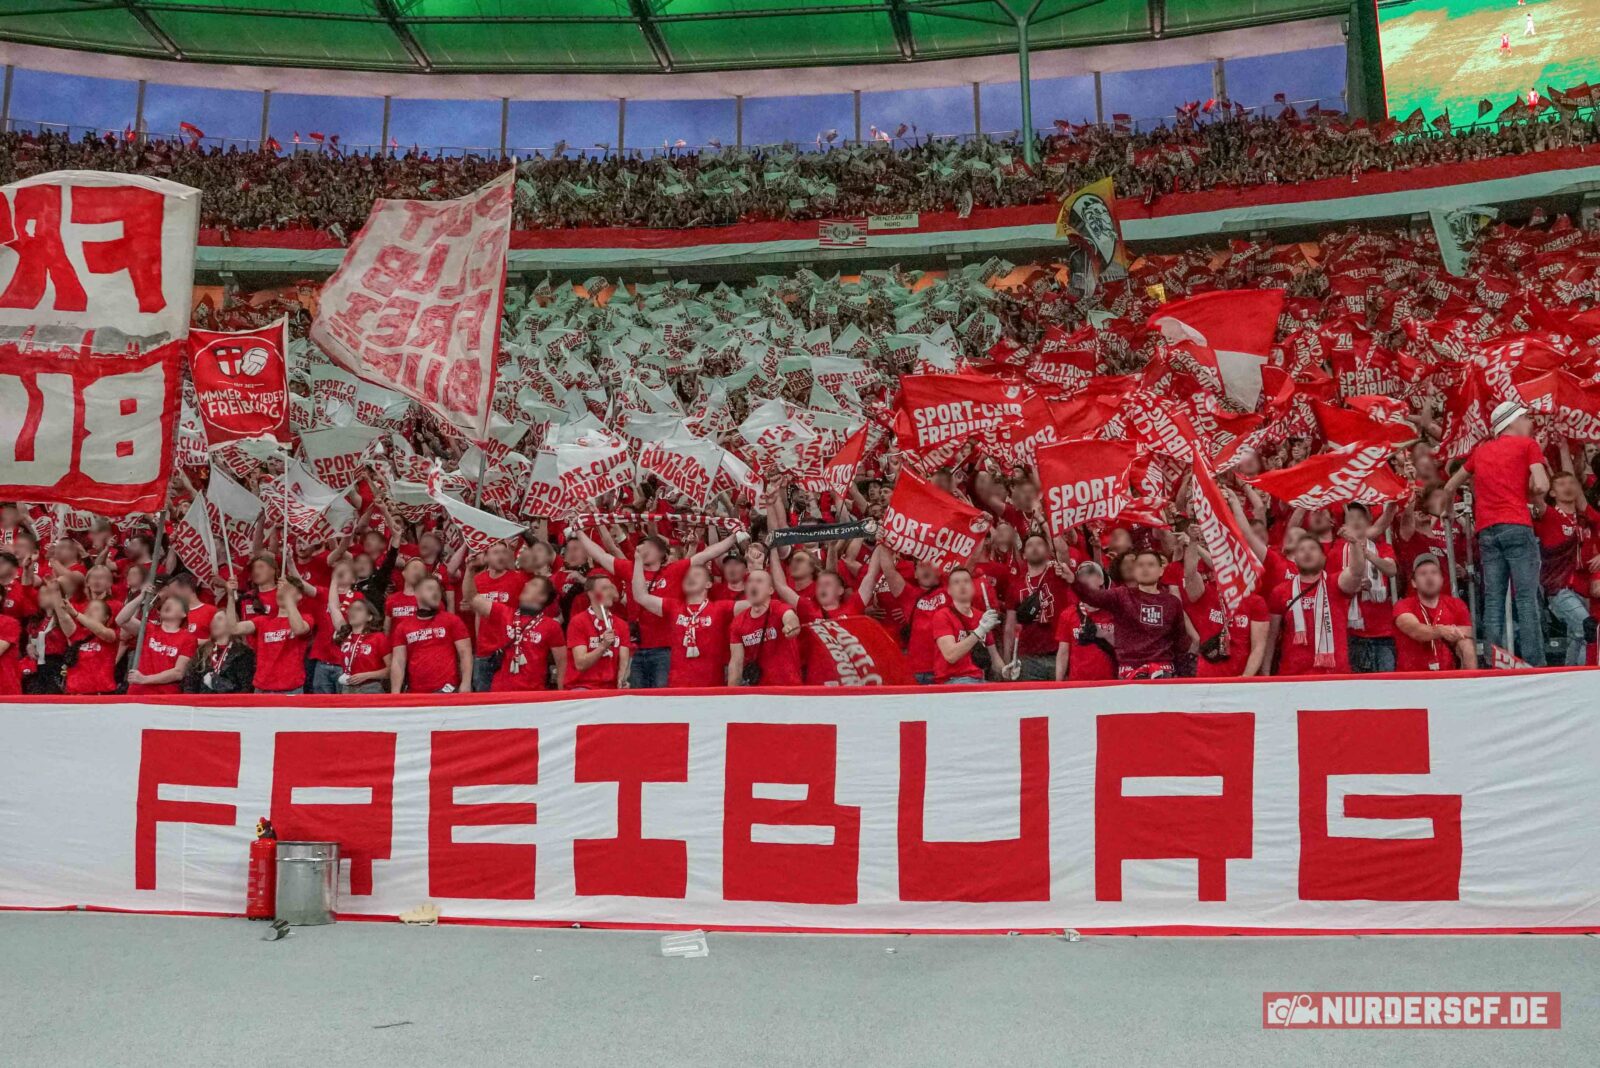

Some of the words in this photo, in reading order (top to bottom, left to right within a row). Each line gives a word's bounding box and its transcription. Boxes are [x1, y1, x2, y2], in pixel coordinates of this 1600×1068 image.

[208, 400, 281, 418] FREIBURG
[1323, 605, 1333, 634] TEAM
[136, 707, 1462, 904] FREIBURG
